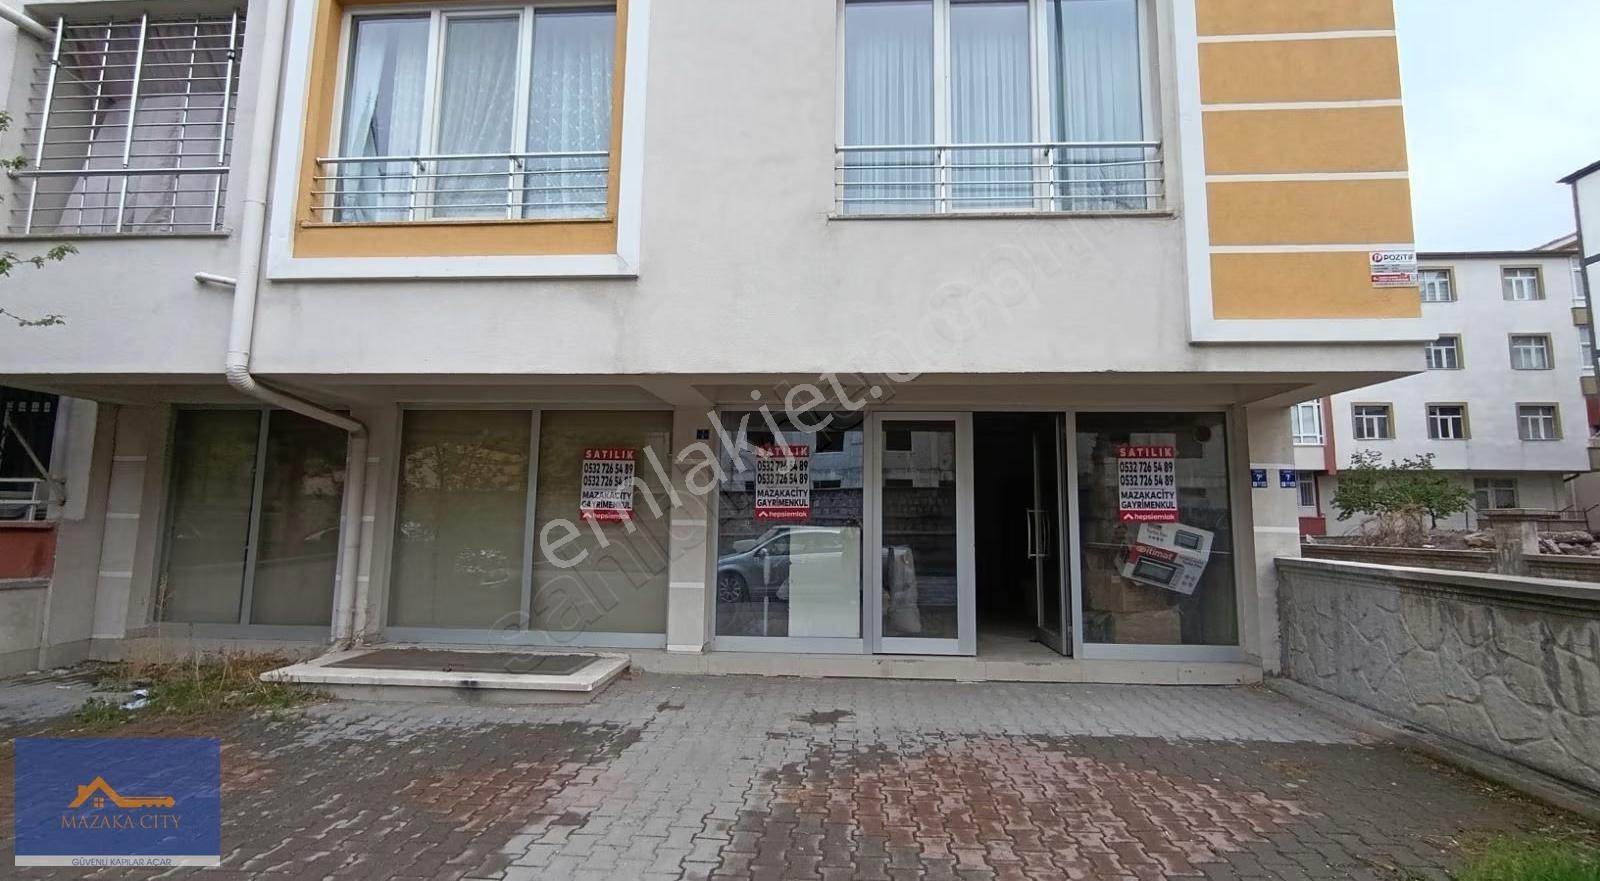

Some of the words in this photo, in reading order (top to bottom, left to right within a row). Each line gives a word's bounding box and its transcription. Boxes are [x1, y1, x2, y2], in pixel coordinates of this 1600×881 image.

[585, 449, 634, 459] SATILIK
[1119, 447, 1172, 457] SATILIK
[584, 463, 600, 474] 0532
[601, 463, 614, 474] 726
[615, 464, 623, 474] 54
[624, 464, 634, 474] 89
[757, 460, 774, 471] 0532
[799, 460, 809, 471] 89
[1120, 461, 1138, 473] 0532
[1139, 461, 1152, 473] 726
[1153, 461, 1162, 473] 54
[1163, 461, 1173, 473] 89
[583, 475, 600, 486] 0532
[600, 476, 613, 487] 726
[757, 473, 774, 484] 0532
[775, 473, 788, 484] 726
[789, 473, 798, 484] 54
[799, 473, 809, 484] 89
[1120, 475, 1138, 486] 0532
[1139, 475, 1152, 486] 726
[1154, 475, 1163, 486] 54
[1164, 475, 1174, 486] 89
